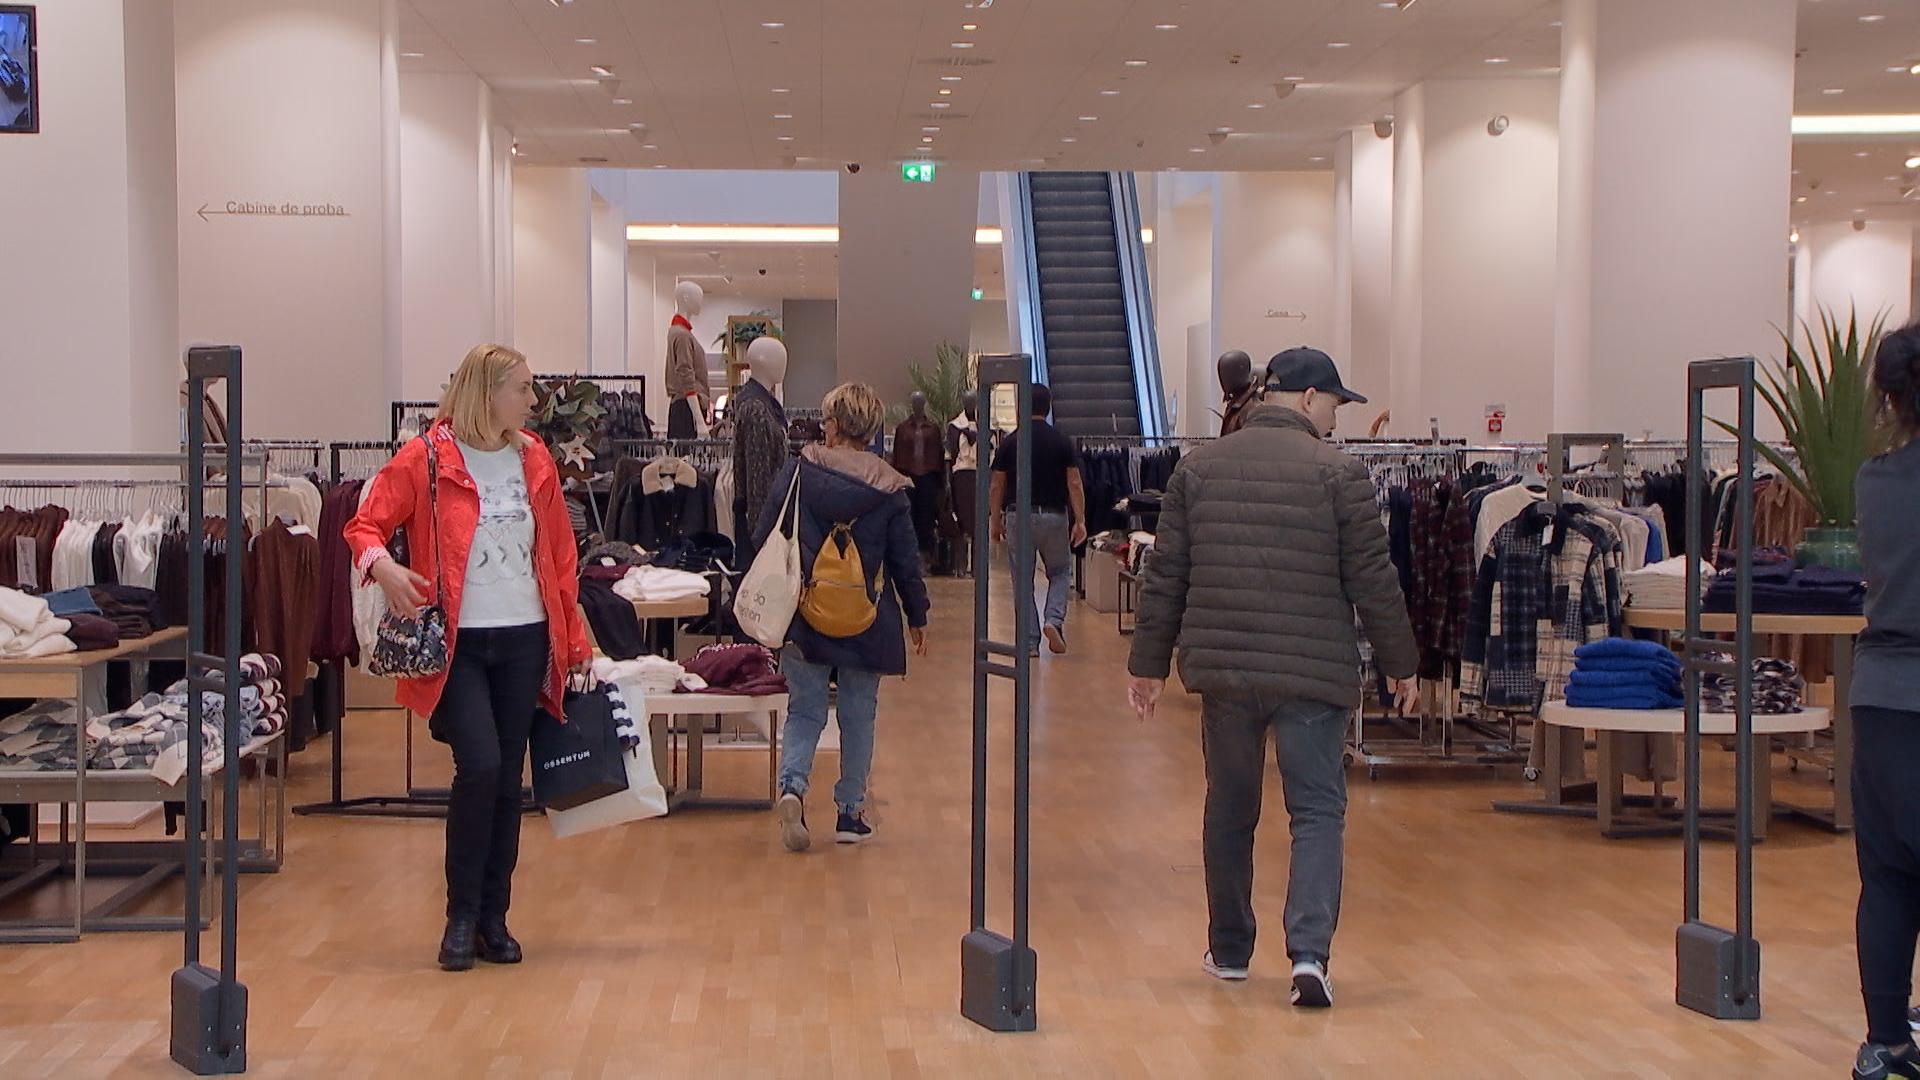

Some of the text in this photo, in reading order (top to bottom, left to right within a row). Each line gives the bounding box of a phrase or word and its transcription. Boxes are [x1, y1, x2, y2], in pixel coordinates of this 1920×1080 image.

[225, 200, 345, 217] Cabine de proba
